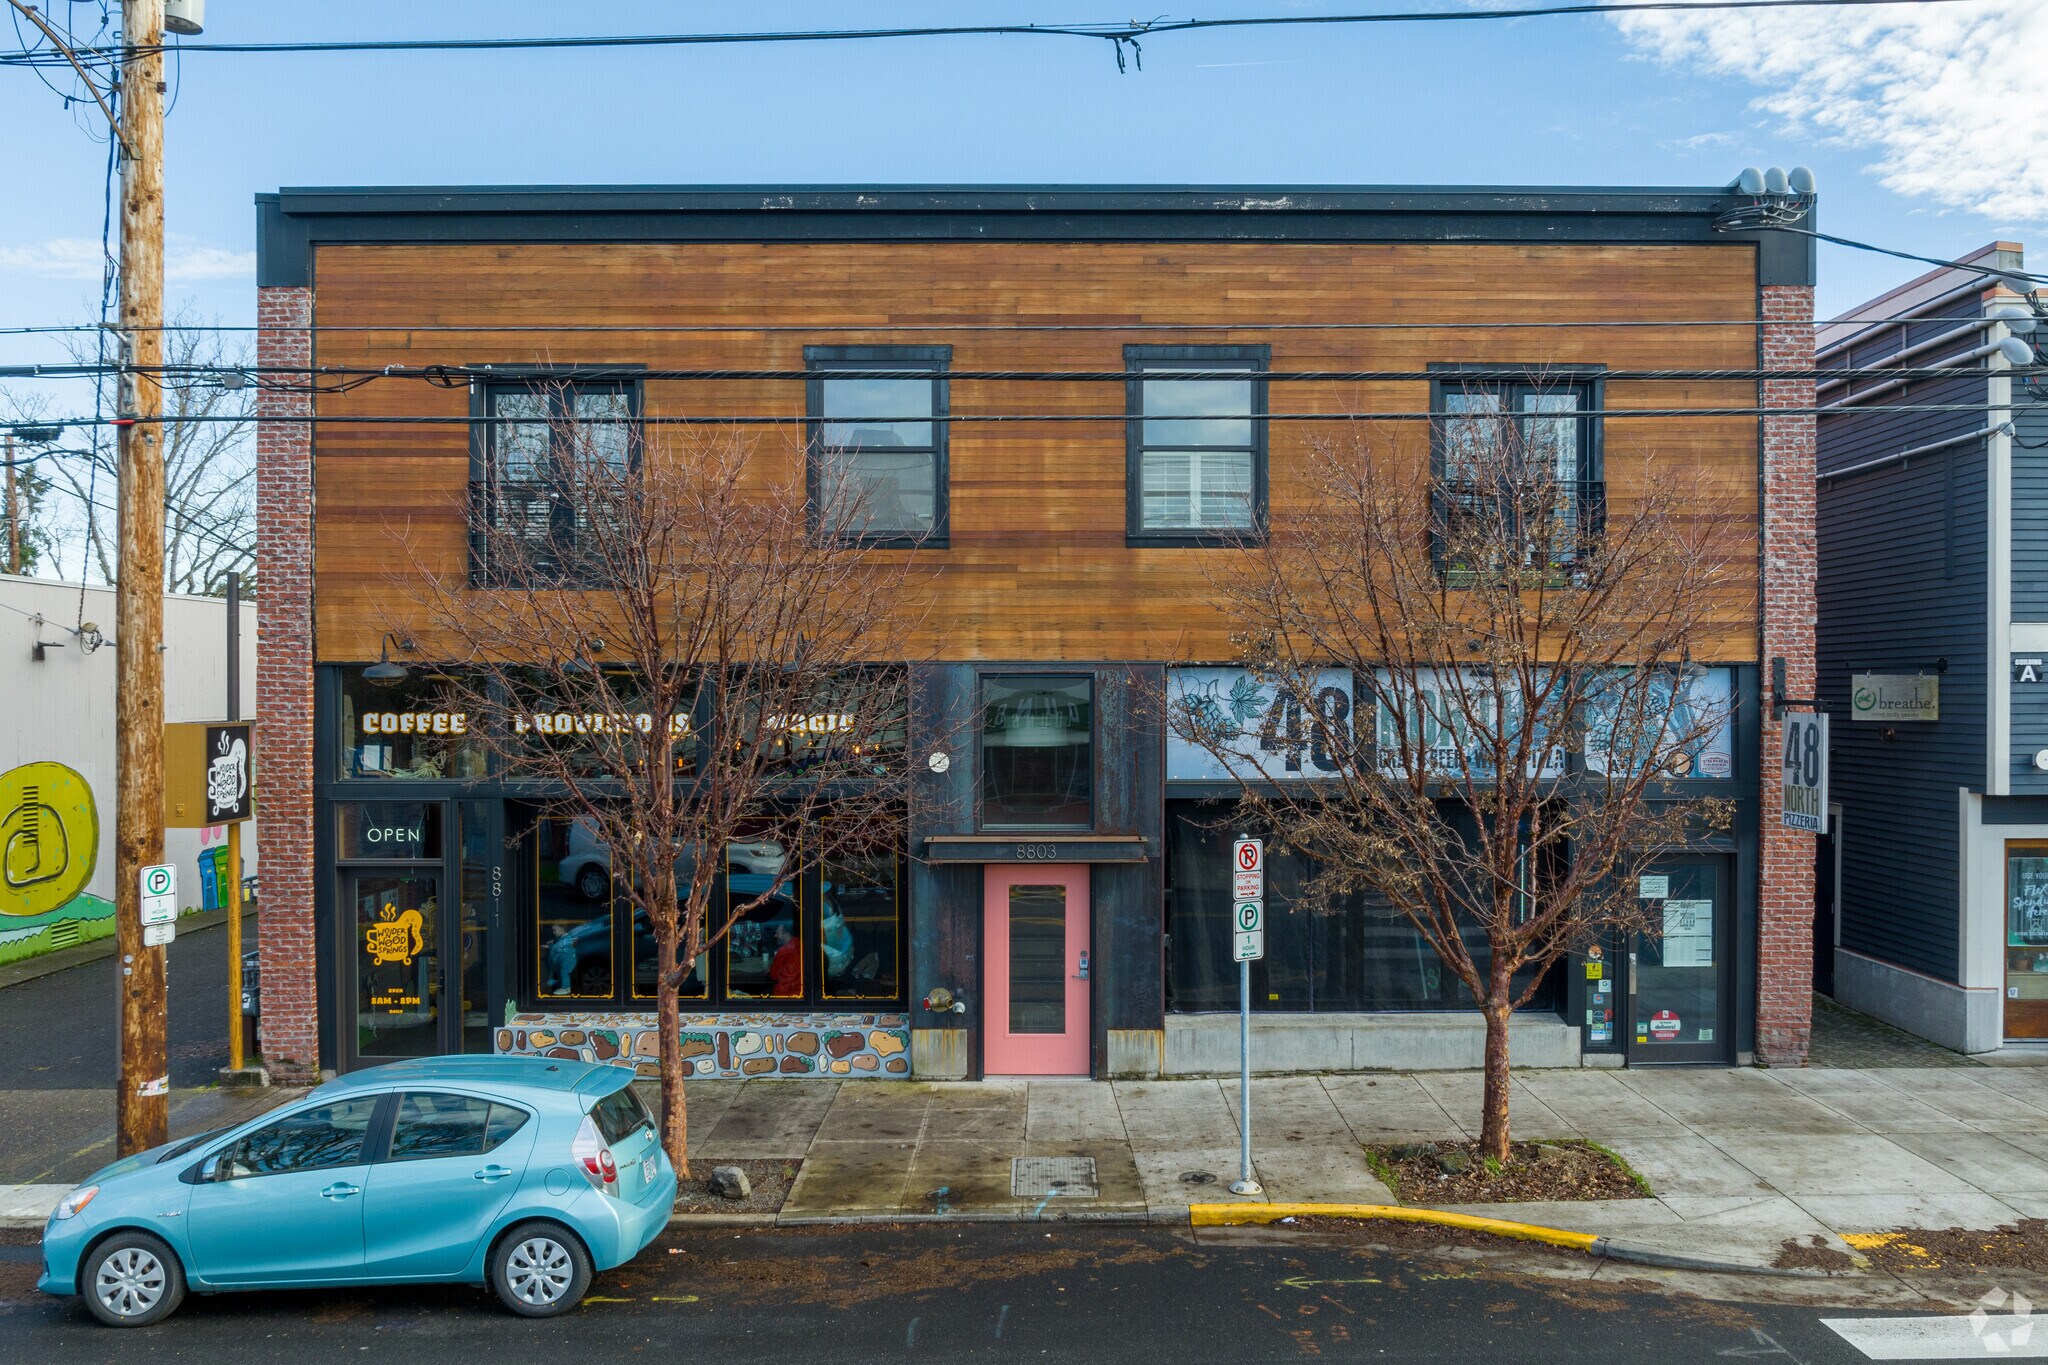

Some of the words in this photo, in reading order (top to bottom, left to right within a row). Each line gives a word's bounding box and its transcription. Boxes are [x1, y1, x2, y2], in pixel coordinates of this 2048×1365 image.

[2020, 665, 2037, 682] A
[362, 712, 468, 734] COFFEE
[1260, 686, 1350, 772] 48
[1784, 721, 1819, 787] 48
[1784, 784, 1819, 815] NORTH
[1784, 812, 1818, 830] PIZZERIA
[367, 828, 420, 842] OPEN
[1016, 844, 1057, 859] 8803
[155, 874, 166, 890] P
[1236, 873, 1260, 881] STOPPING
[1245, 909, 1254, 926] P
[378, 936, 406, 947] WOOD
[1246, 935, 1250, 943] 1
[378, 946, 407, 955] SPRINGS
